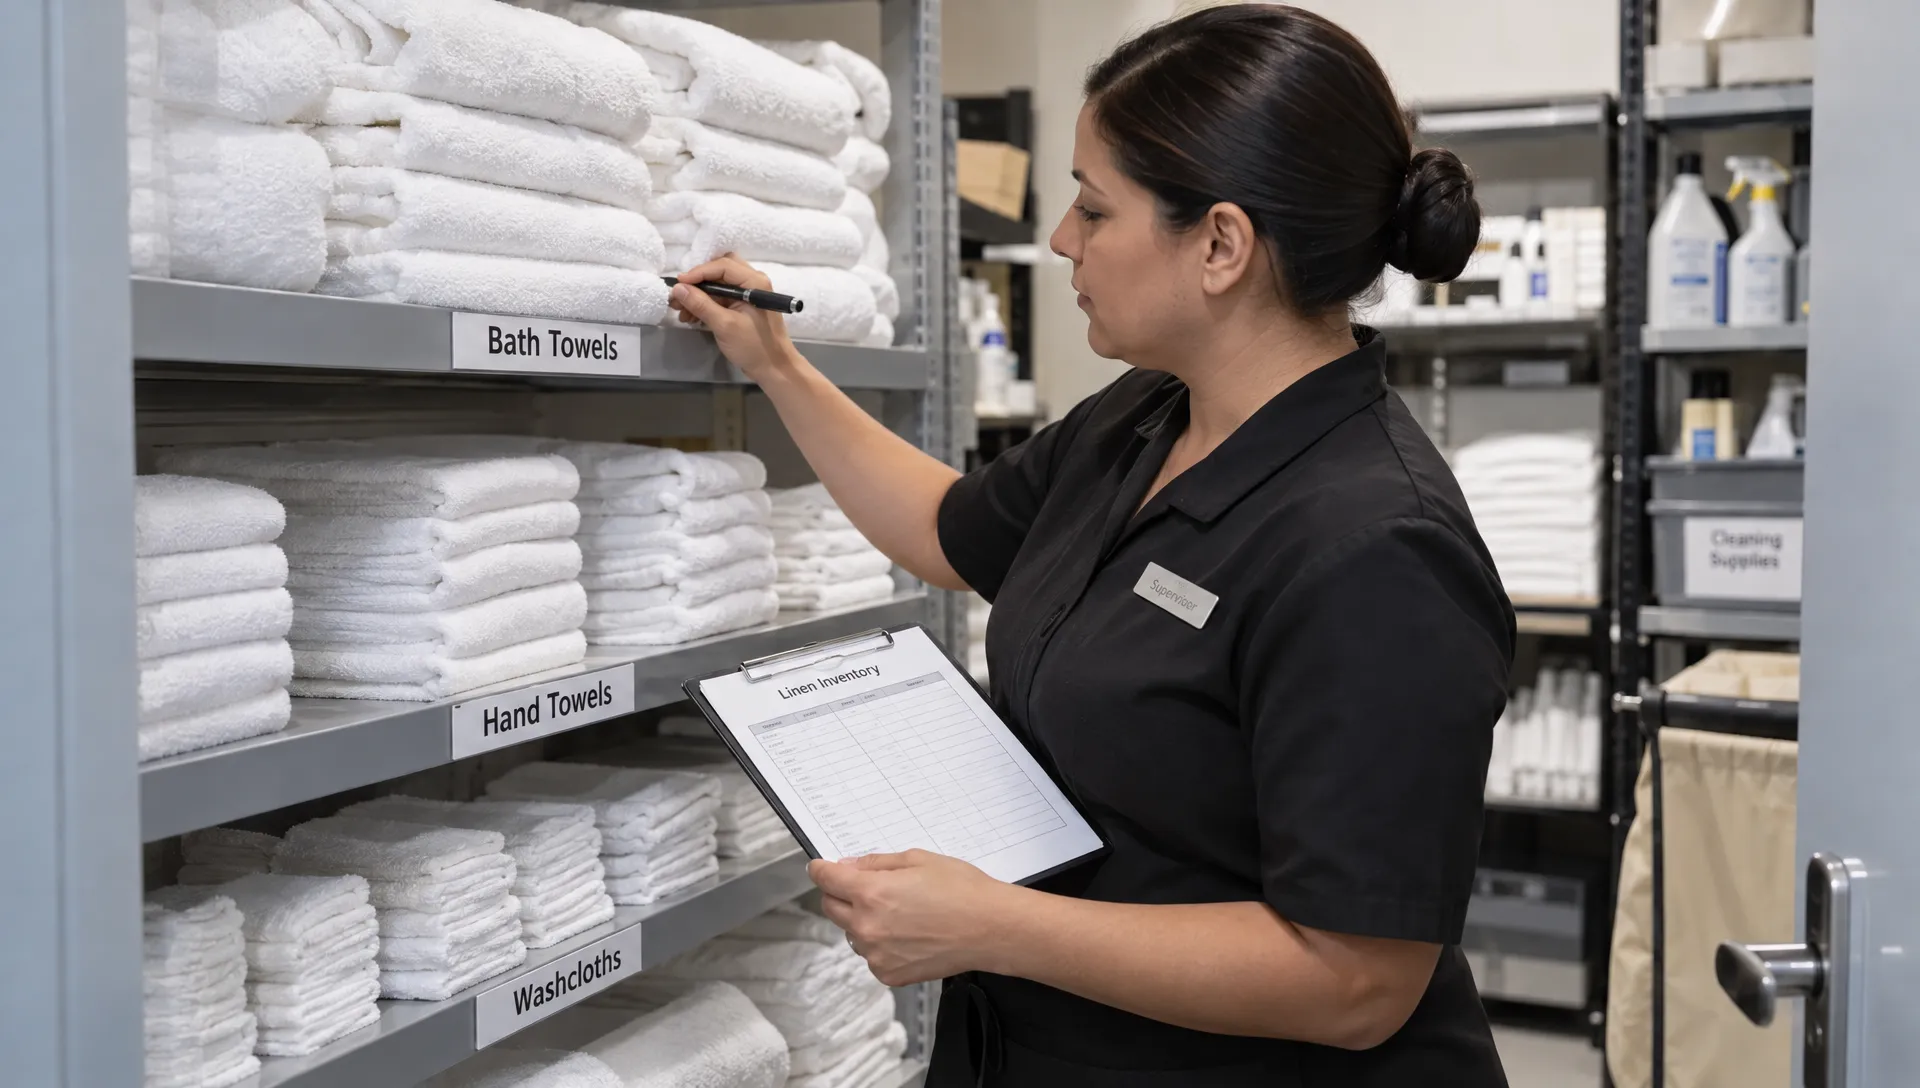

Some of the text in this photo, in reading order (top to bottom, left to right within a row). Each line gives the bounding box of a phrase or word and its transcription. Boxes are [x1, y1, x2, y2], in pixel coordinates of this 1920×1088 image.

[488, 326, 618, 361] Bath Towels
[1711, 530, 1783, 552] Cleaning
[1710, 551, 1780, 573] Supplies
[777, 664, 881, 700] Linen Inventory
[483, 680, 612, 737] Hand Towels
[513, 949, 622, 1016] Washcloths
